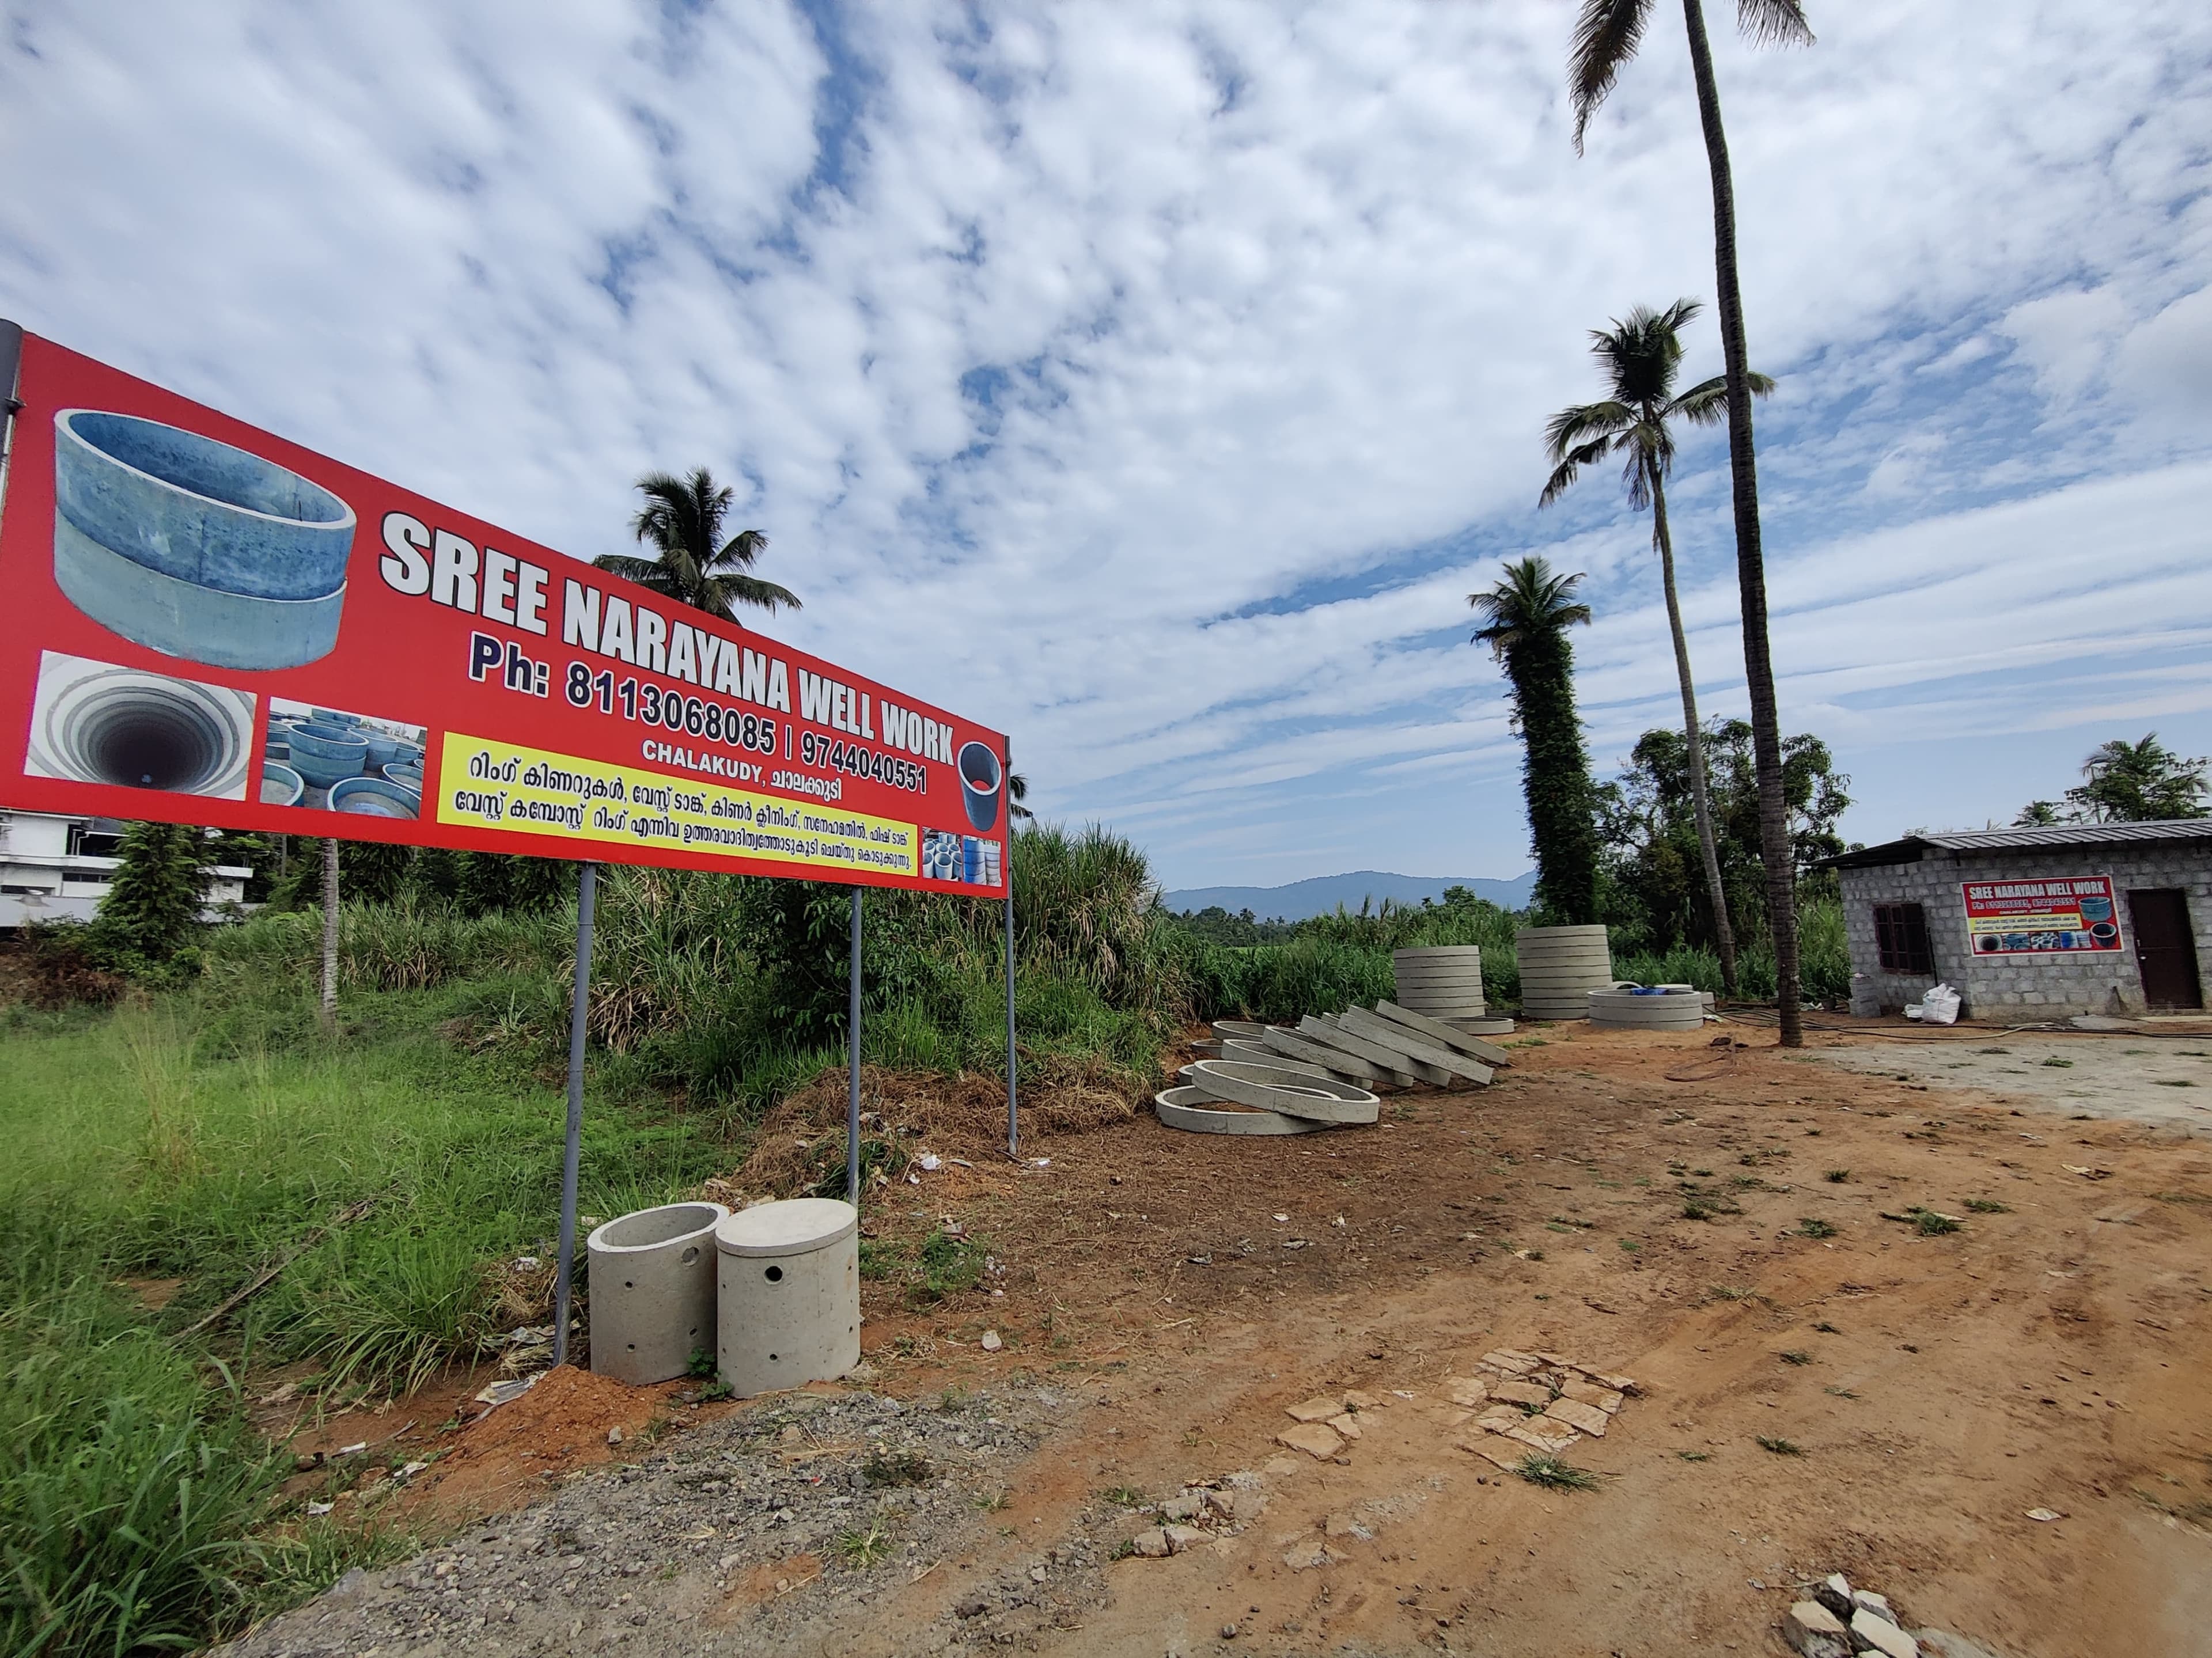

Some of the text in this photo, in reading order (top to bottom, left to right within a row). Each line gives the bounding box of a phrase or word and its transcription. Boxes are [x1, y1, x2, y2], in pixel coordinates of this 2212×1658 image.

[380, 511, 955, 767] SREE NARAYANA WELL WORK
[468, 630, 550, 699] Ph:
[565, 660, 777, 756] 8113068085
[801, 731, 927, 795] 9744040551
[469, 751, 521, 783] റിംഗ്
[711, 796, 752, 821] കിണർ
[641, 739, 842, 802] CHALAKUDY, ചാലക്കുടി
[593, 806, 629, 832] റിംഗ്
[631, 815, 680, 839] എന്നിവ
[1969, 881, 2105, 900] SREE NARAYANA WELL WORK
